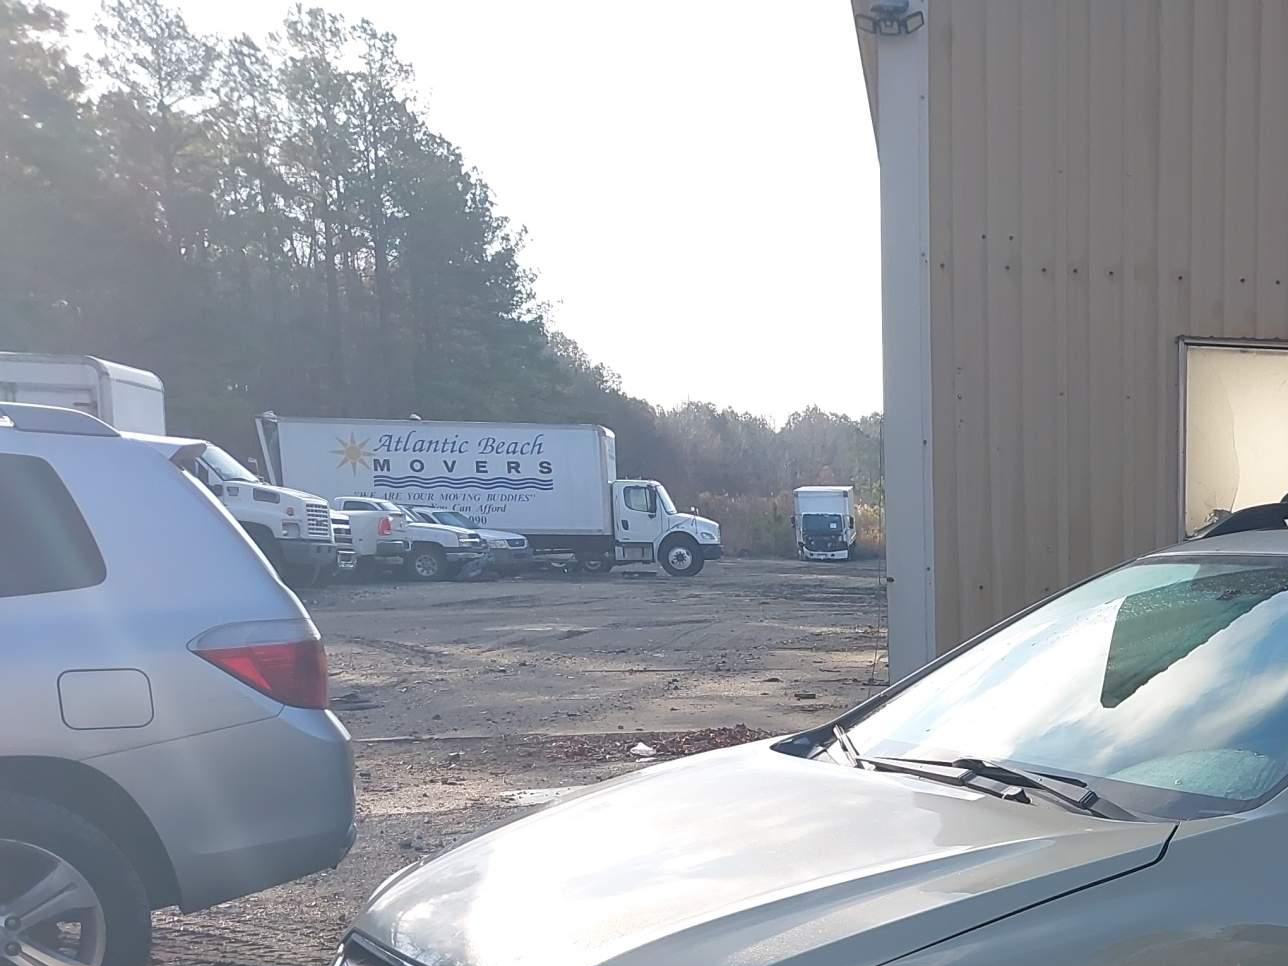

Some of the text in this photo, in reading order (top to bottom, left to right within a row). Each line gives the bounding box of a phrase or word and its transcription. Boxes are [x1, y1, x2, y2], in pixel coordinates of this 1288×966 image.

[373, 430, 544, 456] Atlantic Beach
[373, 458, 553, 475] MOVERS
[407, 492, 434, 501] YOUR
[440, 492, 481, 502] MOVING
[452, 503, 472, 513] Can
